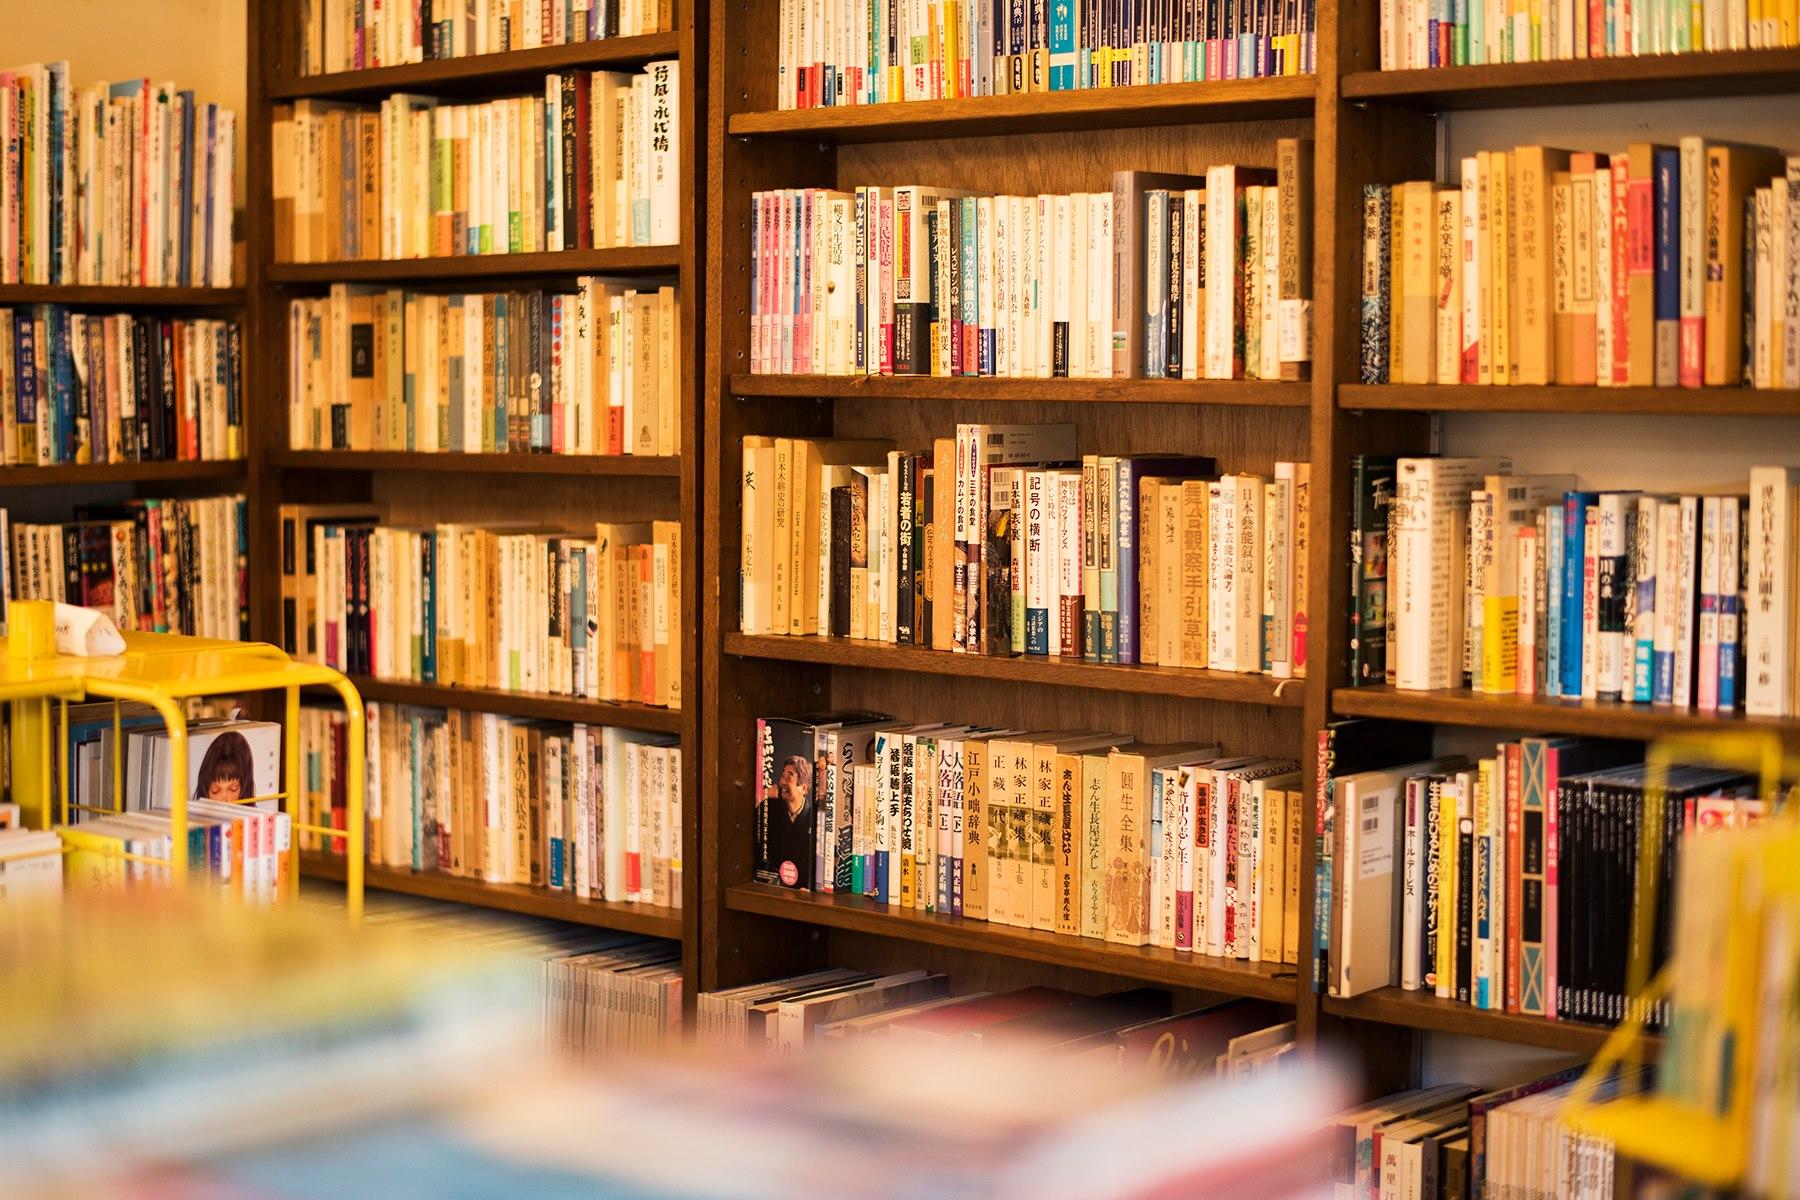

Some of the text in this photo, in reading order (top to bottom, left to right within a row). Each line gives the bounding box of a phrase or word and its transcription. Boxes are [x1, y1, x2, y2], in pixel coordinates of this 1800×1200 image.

[1282, 154, 1297, 300] 世界史を変えた50の動
[900, 491, 912, 547] 若者の街
[1029, 476, 1041, 553] 記号の横断
[938, 749, 953, 807] 大落語
[953, 751, 964, 810] 大落語
[1120, 770, 1134, 854] 圓生全集
[1088, 777, 1101, 870] 志ん生長屋ばなし
